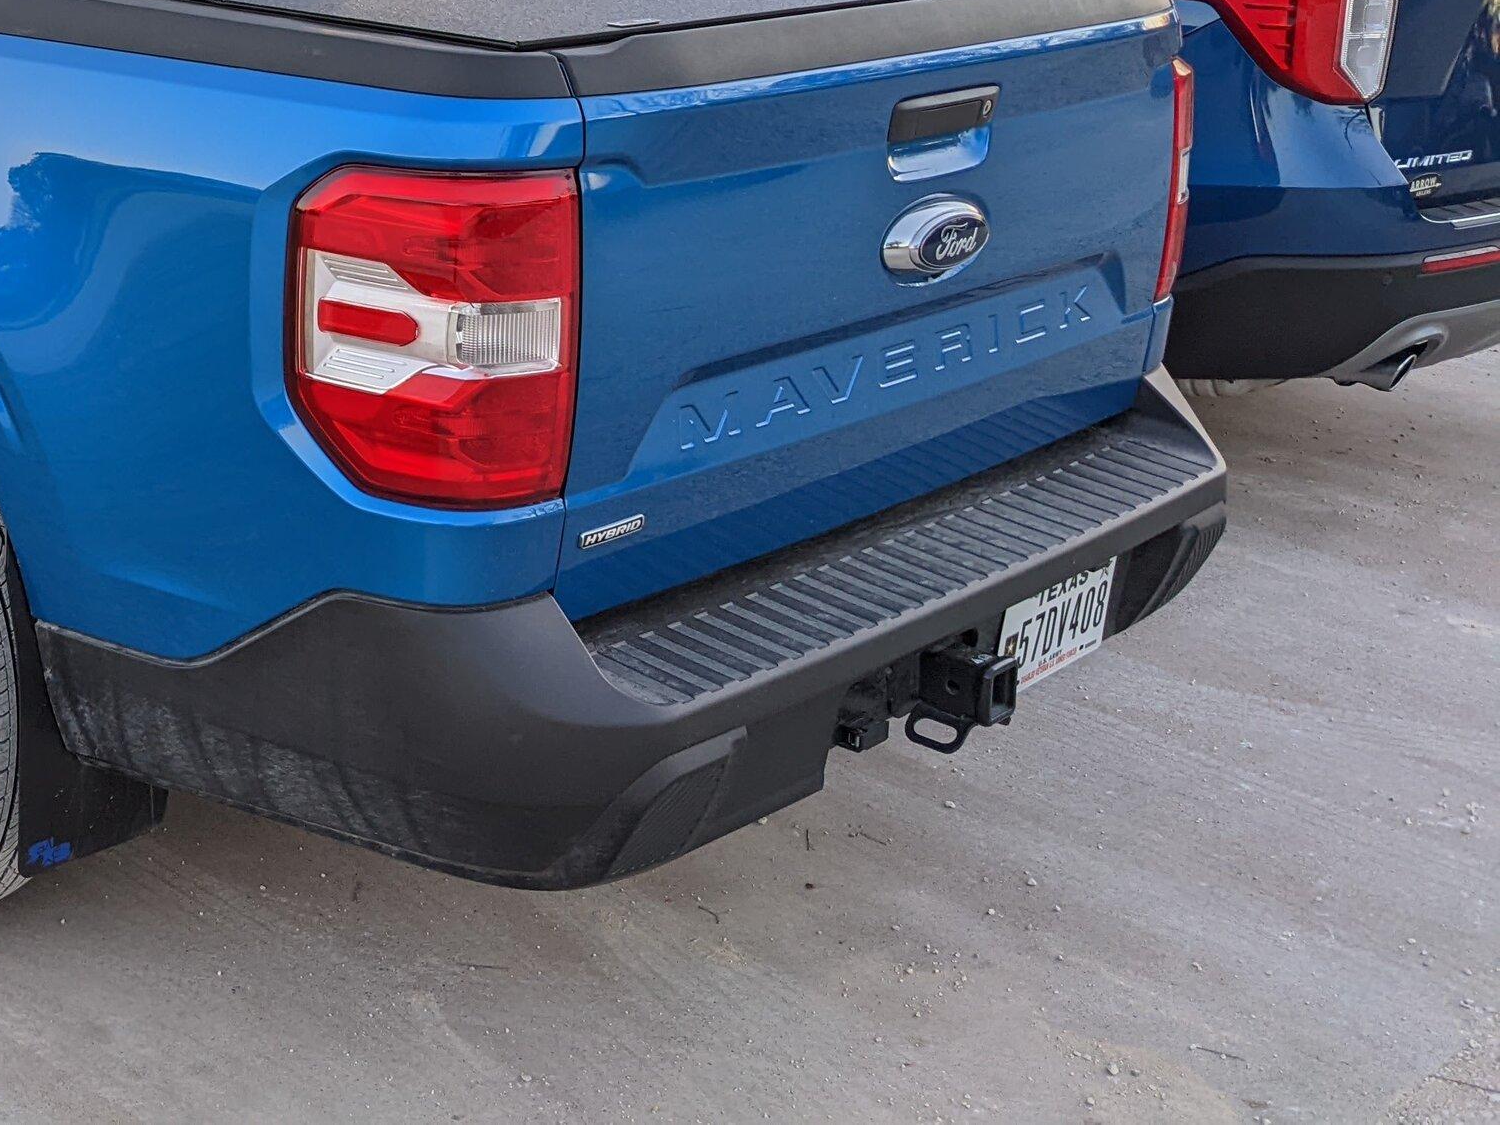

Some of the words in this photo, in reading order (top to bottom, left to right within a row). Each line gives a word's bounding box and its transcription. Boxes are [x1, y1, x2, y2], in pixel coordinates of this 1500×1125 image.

[1394, 149, 1473, 168] LIMITED
[1410, 176, 1438, 190] ARROW
[935, 221, 979, 261] Ford
[679, 284, 1091, 450] MAVERICK
[584, 519, 642, 546] HYBRID
[1039, 569, 1089, 607] TEXAS
[1017, 579, 1108, 669] 57DV408
